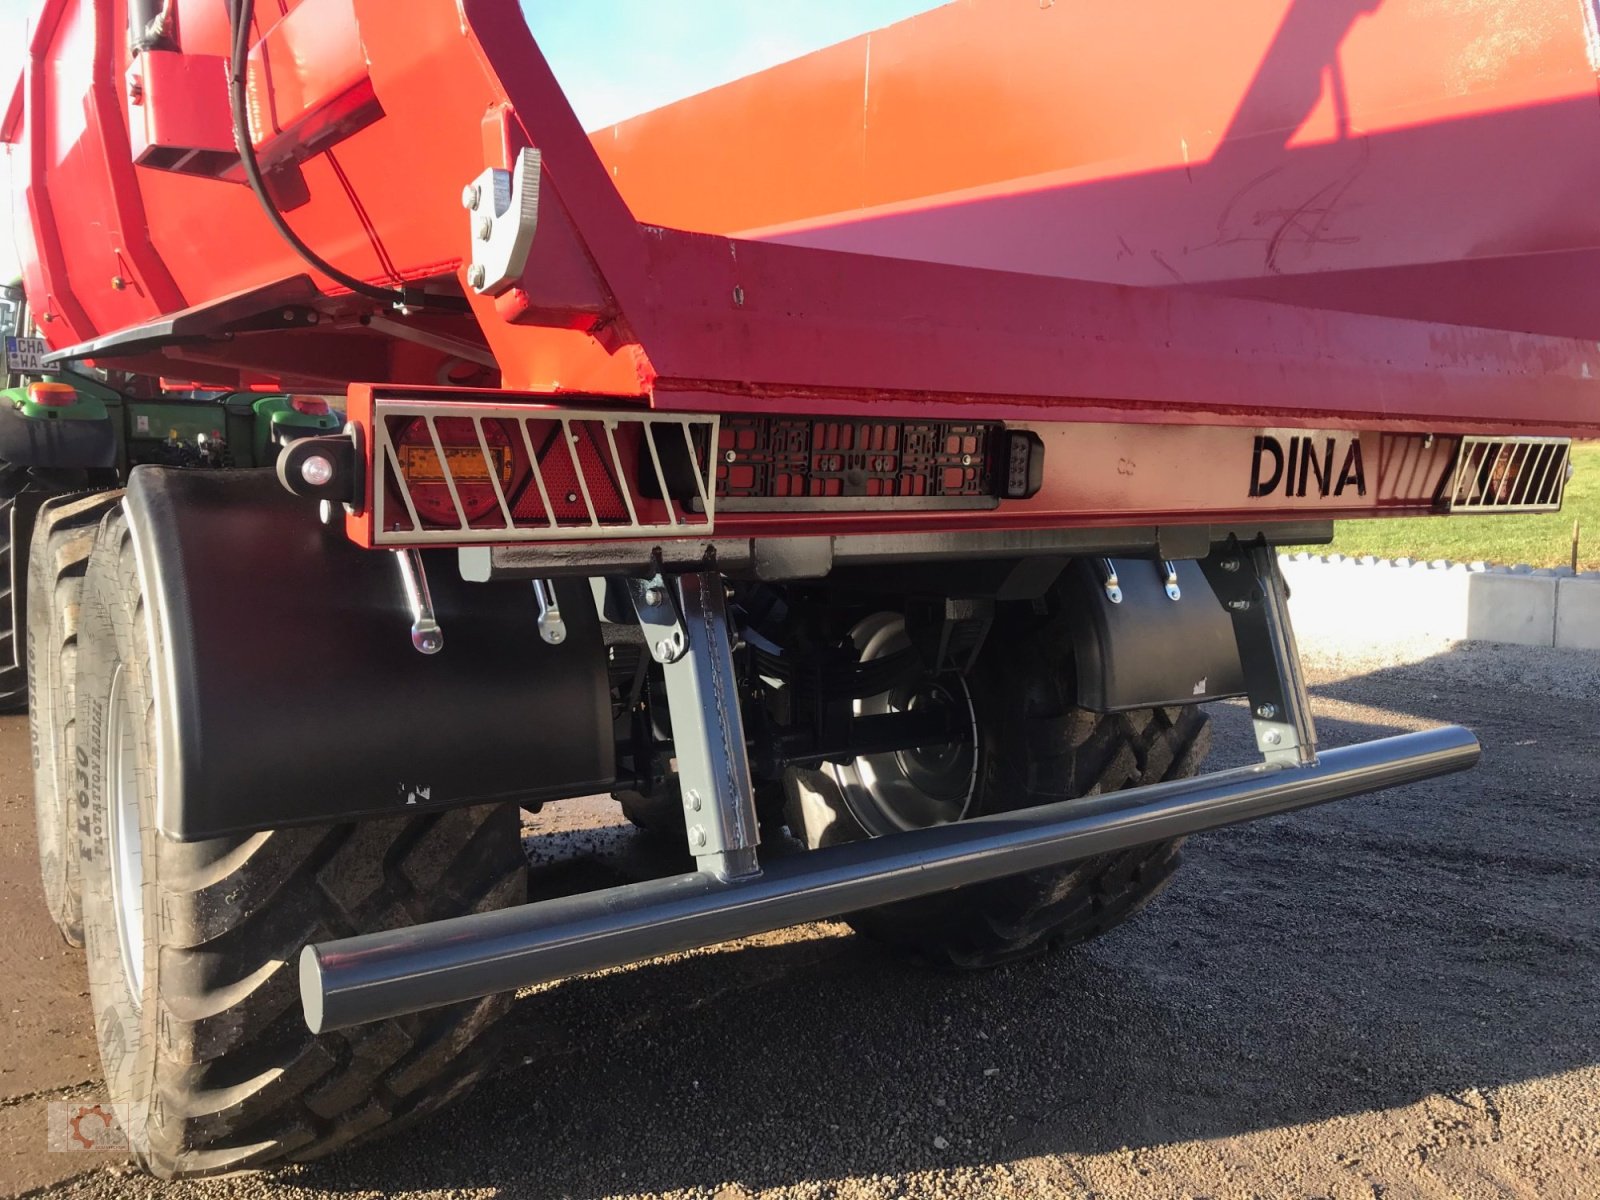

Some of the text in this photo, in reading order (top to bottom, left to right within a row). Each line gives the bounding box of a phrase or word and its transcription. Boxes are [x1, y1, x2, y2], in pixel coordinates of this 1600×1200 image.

[18, 340, 44, 354] CHA
[20, 354, 37, 368] WA
[1248, 436, 1367, 498] DINA
[75, 745, 90, 809] 630
[91, 698, 104, 856] FLOTATION RADIAL
